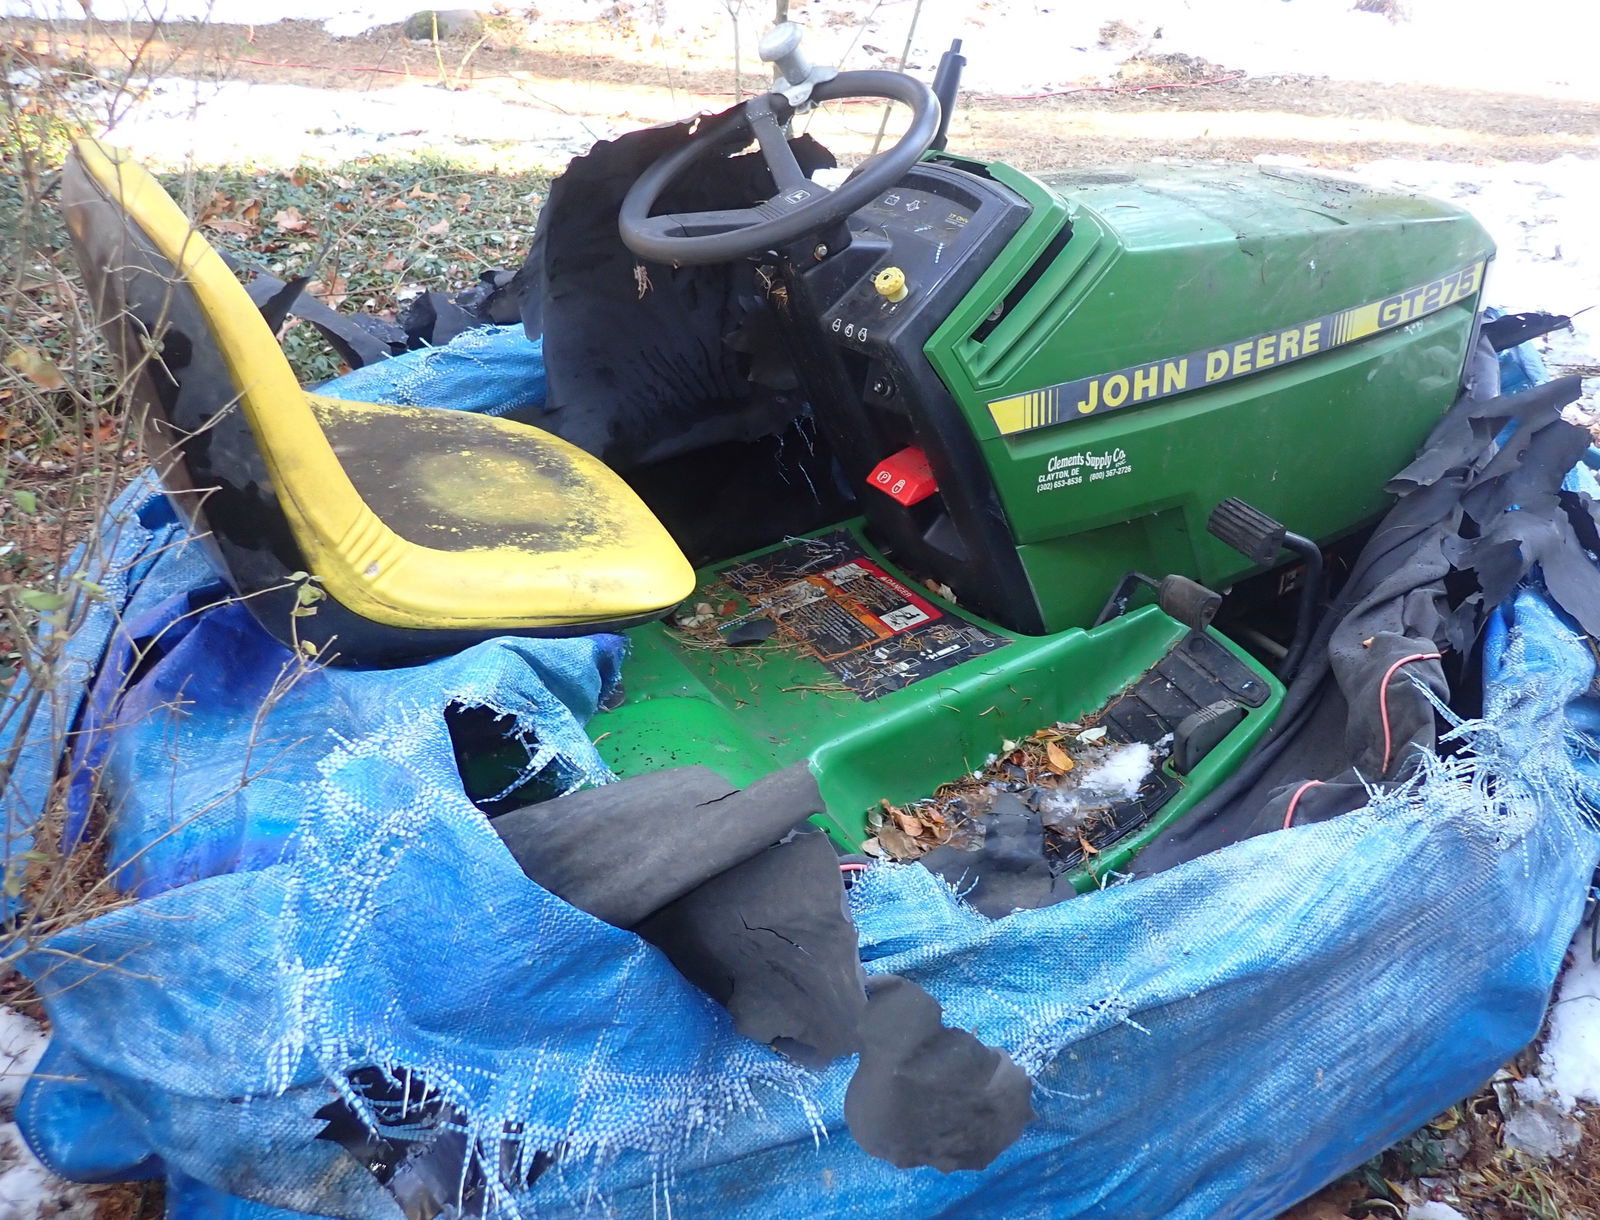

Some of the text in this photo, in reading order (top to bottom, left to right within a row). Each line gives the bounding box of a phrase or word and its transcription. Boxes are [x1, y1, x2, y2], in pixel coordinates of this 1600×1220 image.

[1077, 272, 1476, 415] JOHN DEERE GT275
[1047, 452, 1085, 472] Clements
[1085, 450, 1112, 469] Supply
[1038, 467, 1080, 483] CLAYTON, DE
[1036, 482, 1053, 493] (302)
[886, 578, 913, 598] DANGER
